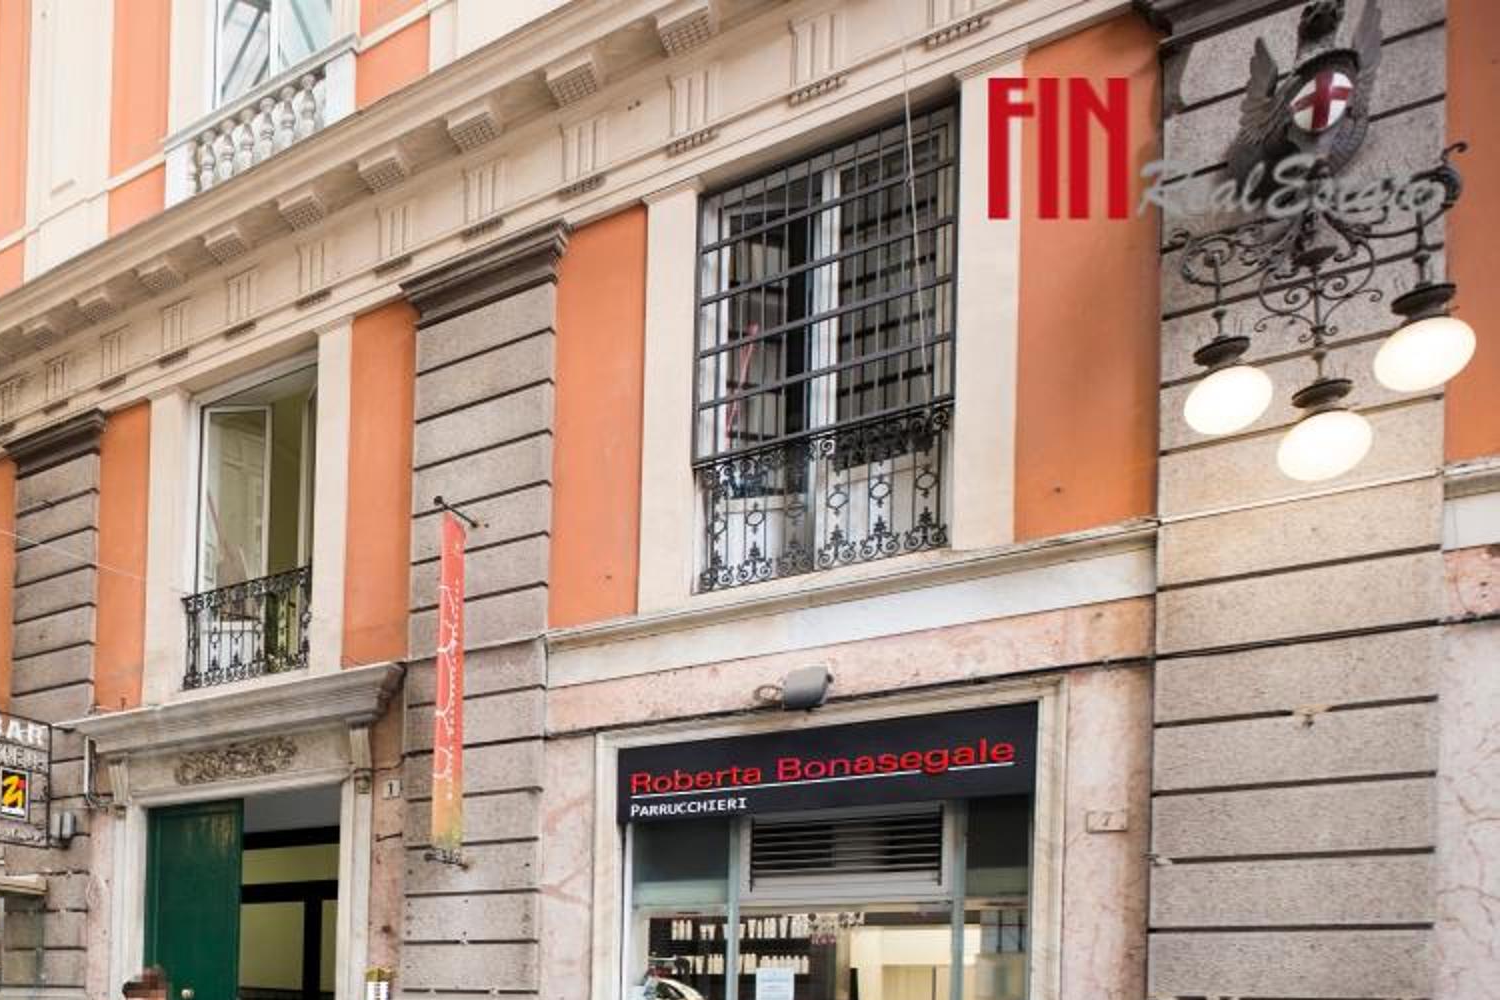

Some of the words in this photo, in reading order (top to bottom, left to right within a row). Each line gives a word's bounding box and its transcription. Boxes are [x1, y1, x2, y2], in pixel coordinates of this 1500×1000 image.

[630, 766, 762, 795] Roberta
[776, 738, 1014, 783] Bonasegale
[630, 798, 748, 817] PARRUCCHIERI
